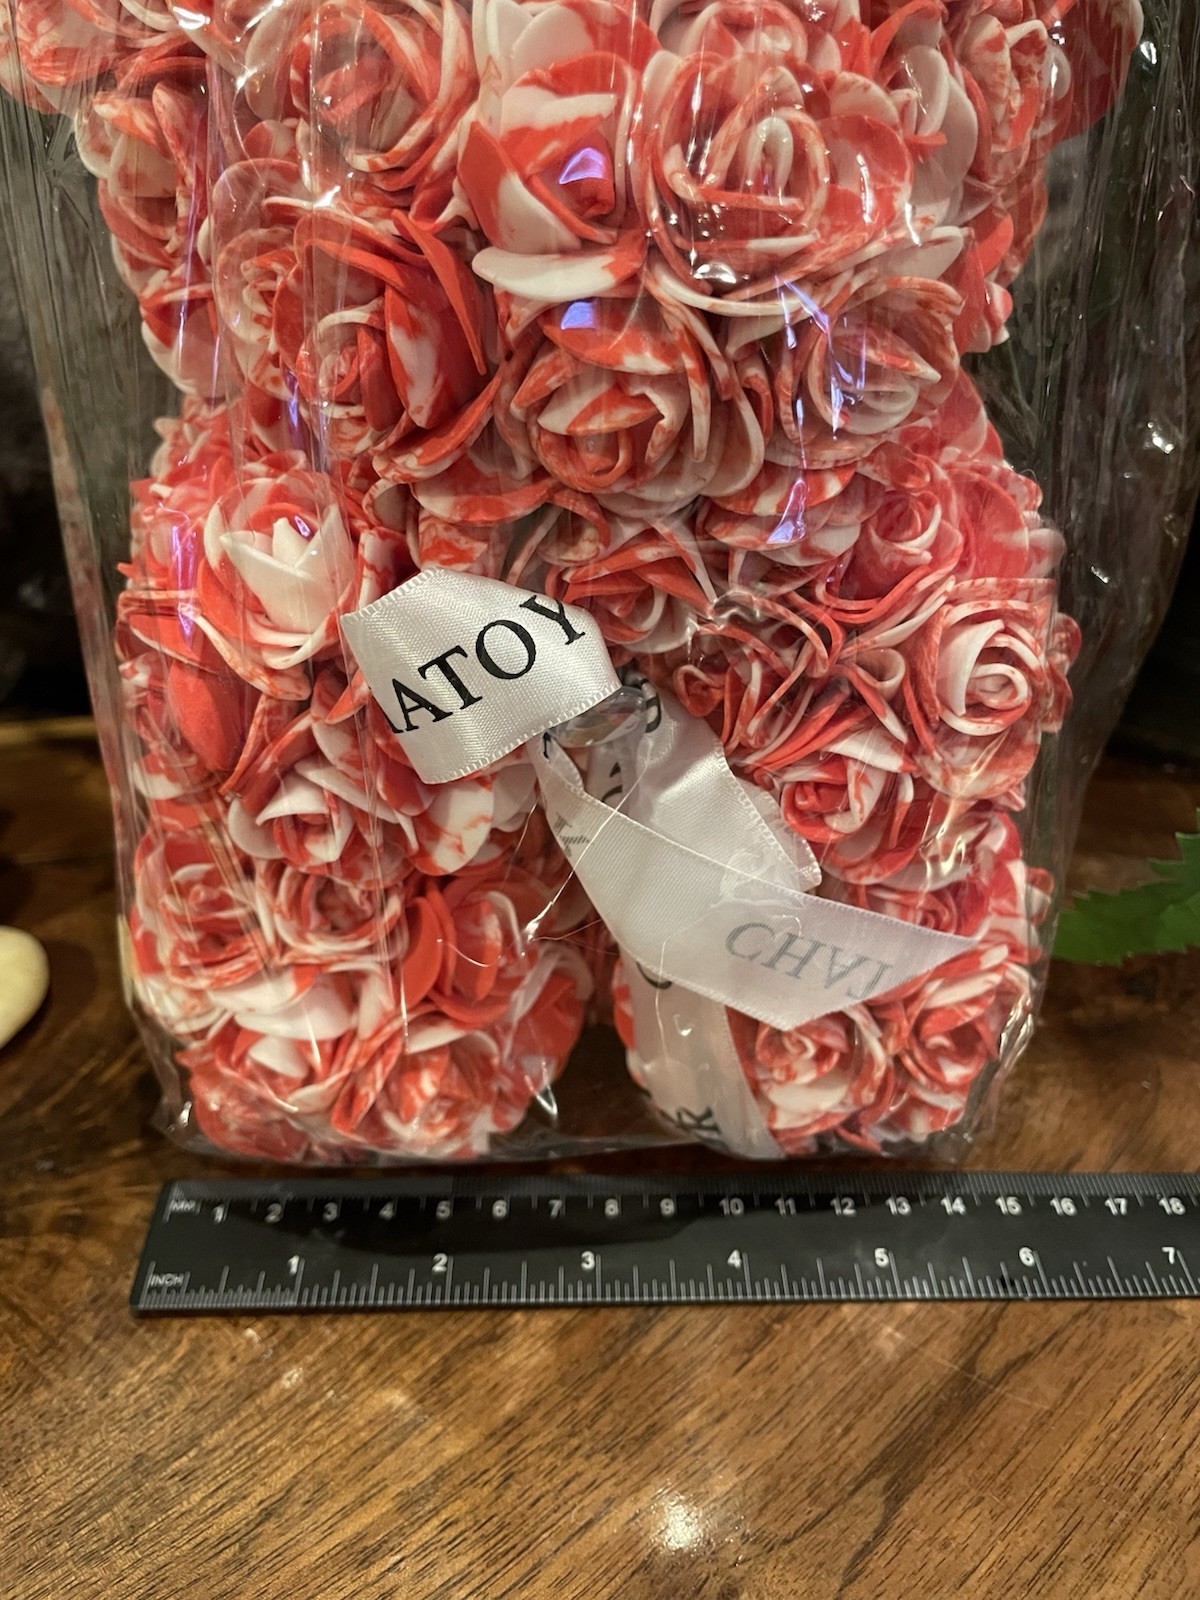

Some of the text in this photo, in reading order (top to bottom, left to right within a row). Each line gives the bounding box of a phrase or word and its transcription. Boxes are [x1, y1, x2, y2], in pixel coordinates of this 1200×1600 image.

[384, 594, 586, 734] ATOY
[212, 1203, 224, 1223] 1
[264, 1202, 282, 1223] 2
[323, 1202, 338, 1221] 3
[378, 1201, 394, 1220] 4
[435, 1200, 451, 1219] 5
[492, 1199, 507, 1218] 6
[549, 1199, 562, 1218] 7
[604, 1198, 619, 1217] 8
[660, 1198, 675, 1216] 9
[718, 1197, 744, 1216] 10
[775, 1197, 796, 1216] 11
[830, 1197, 857, 1216] 12
[885, 1196, 911, 1216] 13
[940, 1196, 966, 1216] 14
[995, 1197, 1022, 1216] 15
[1050, 1197, 1077, 1216] 16
[1105, 1197, 1127, 1216] 17
[1159, 1196, 1186, 1216] 18
[150, 1246, 1176, 1286] INCH 1 2 3 4 5 6 7
